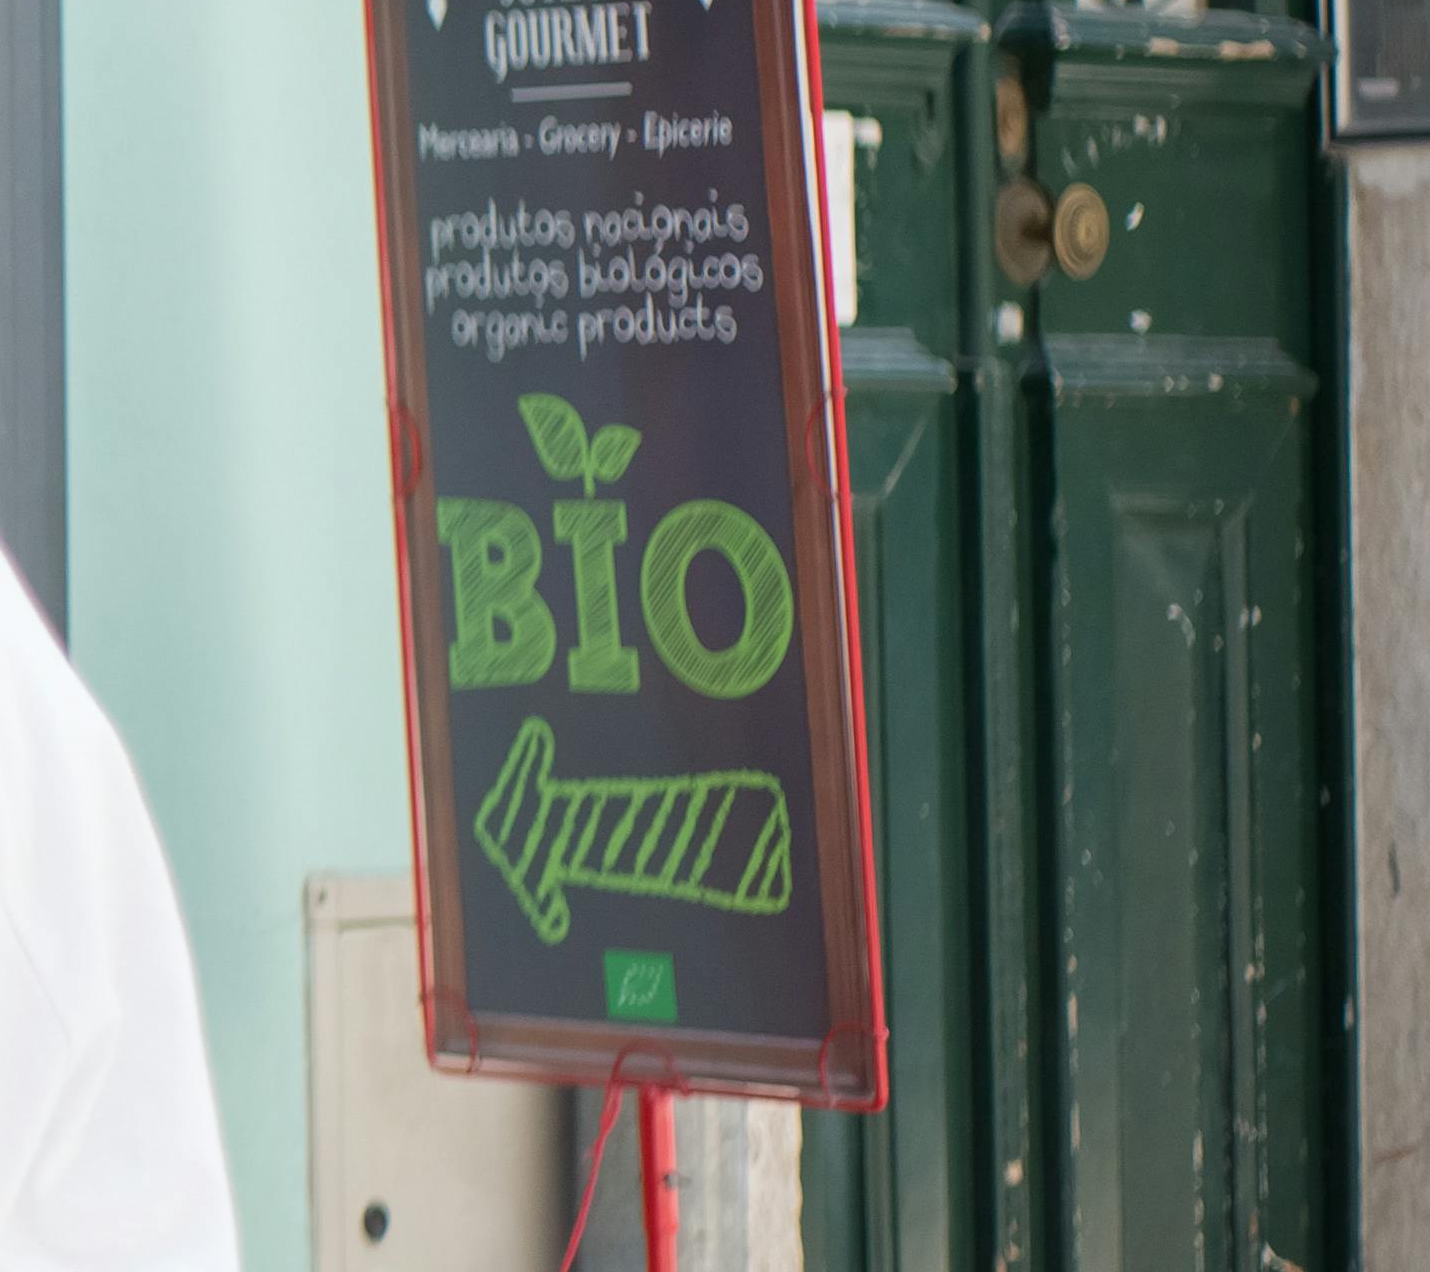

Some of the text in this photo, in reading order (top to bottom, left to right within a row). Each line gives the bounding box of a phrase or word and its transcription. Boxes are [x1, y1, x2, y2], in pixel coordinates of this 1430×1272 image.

[484, 0, 654, 85] GOURMET
[538, 114, 621, 161] Grocery
[429, 197, 576, 266] produtos
[424, 245, 570, 316] produtos
[451, 292, 737, 362] organic products
[435, 495, 795, 700] BIO
